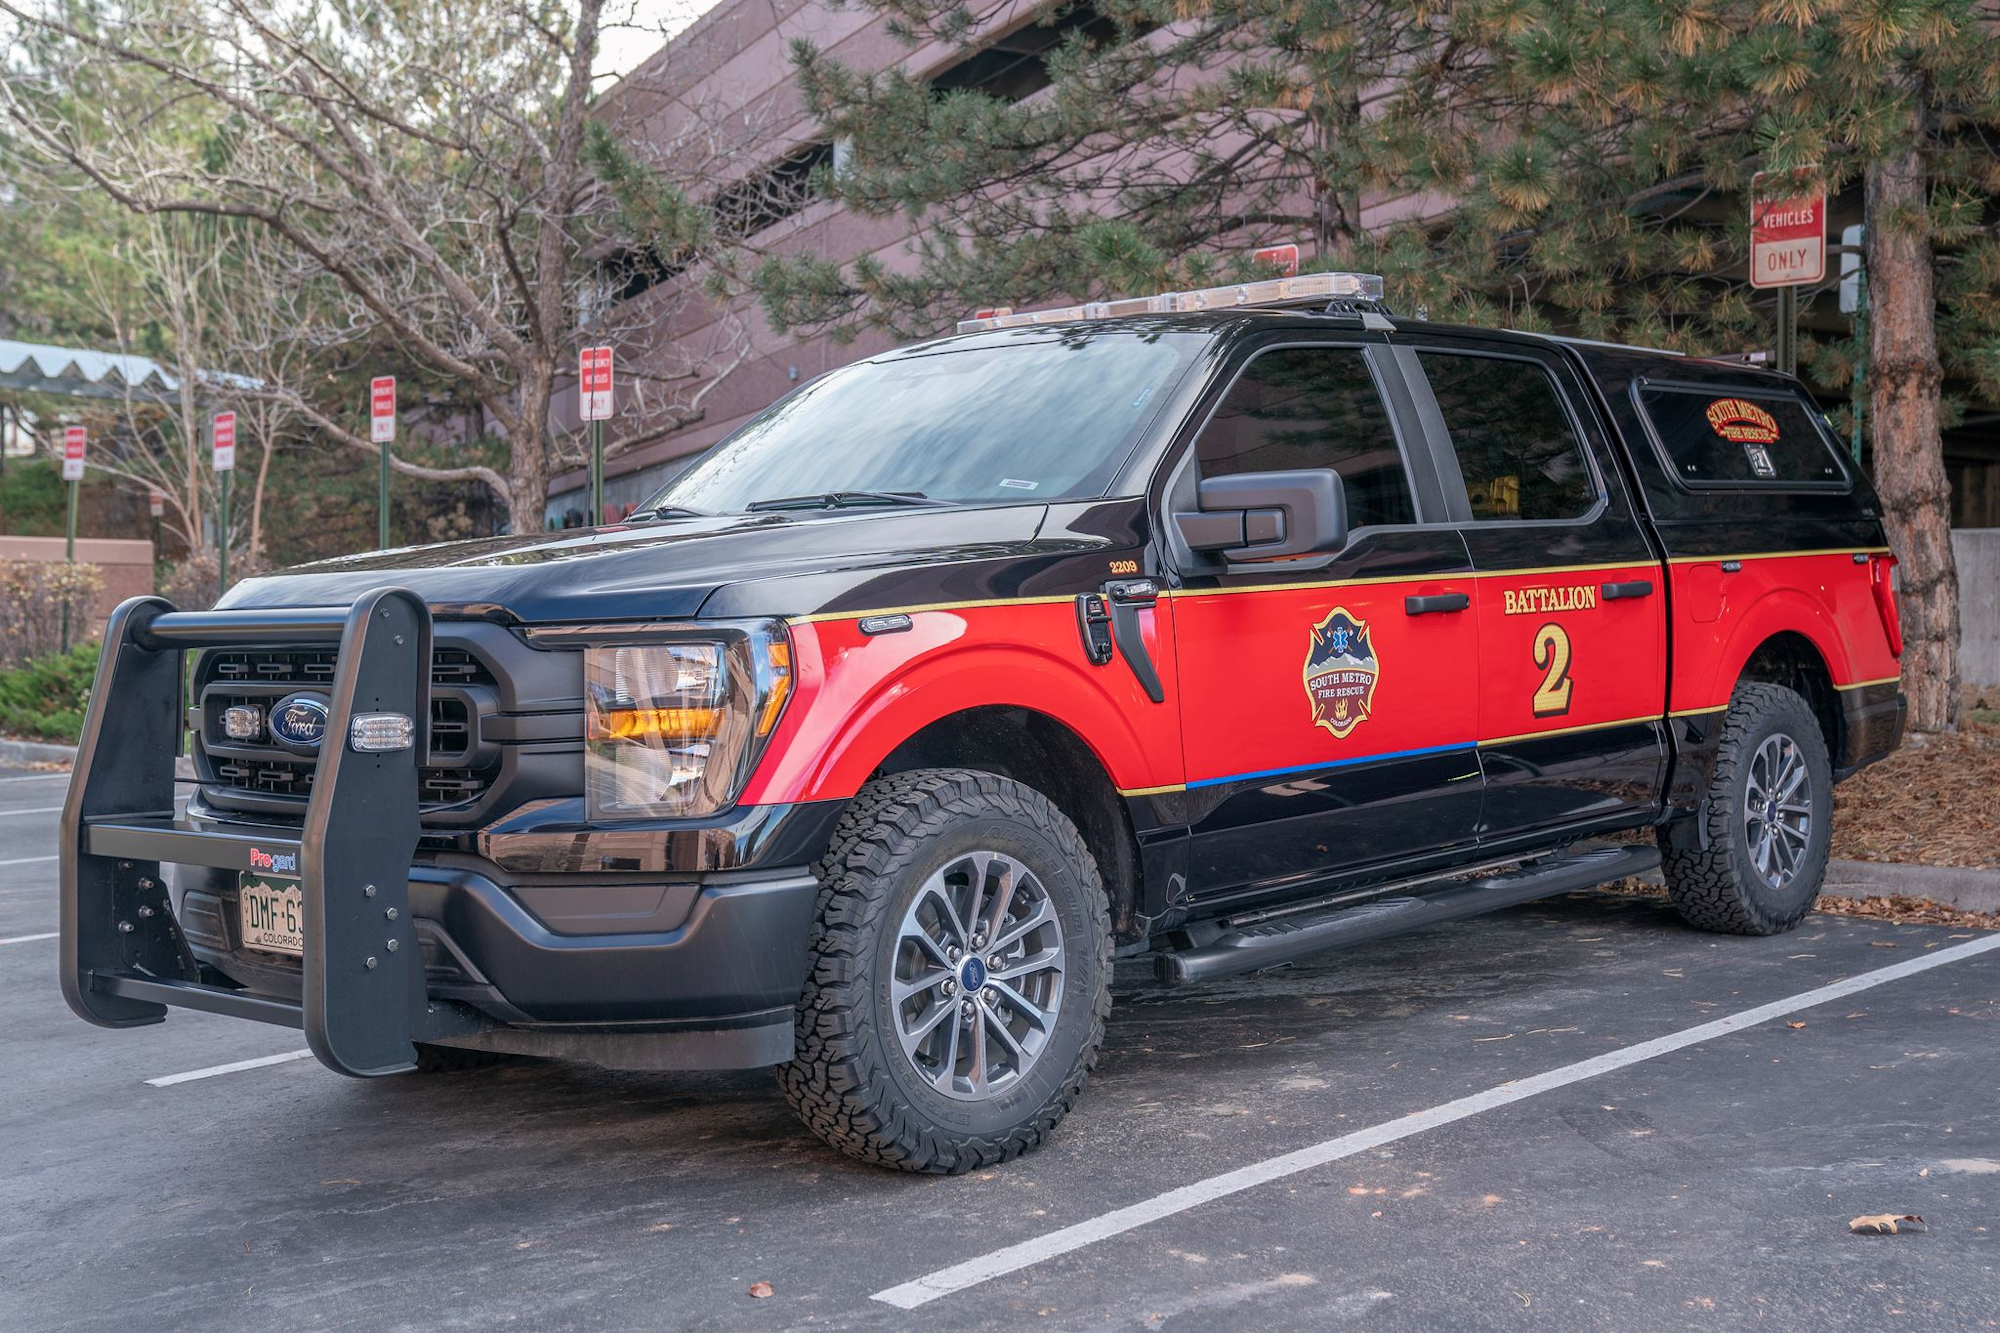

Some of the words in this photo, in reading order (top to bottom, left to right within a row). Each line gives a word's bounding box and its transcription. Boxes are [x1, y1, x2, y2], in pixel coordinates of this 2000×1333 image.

[1763, 209, 1814, 229] VEHICLES
[1767, 248, 1808, 271] ONLY
[1707, 400, 1740, 430] SOUTH
[1734, 400, 1777, 433] METRO
[1725, 427, 1744, 439] FIRE
[1742, 427, 1772, 441] RESCUE
[1109, 560, 1139, 574] 2209
[1503, 585, 1596, 615] BATTALION
[1532, 622, 1573, 719] 2
[1310, 673, 1340, 691] SOUTH
[1341, 672, 1372, 686] METRO
[1318, 688, 1338, 699] FIRE
[1336, 686, 1365, 697] RESCUE
[282, 709, 317, 737] Ford
[1330, 717, 1353, 727] COLORADO
